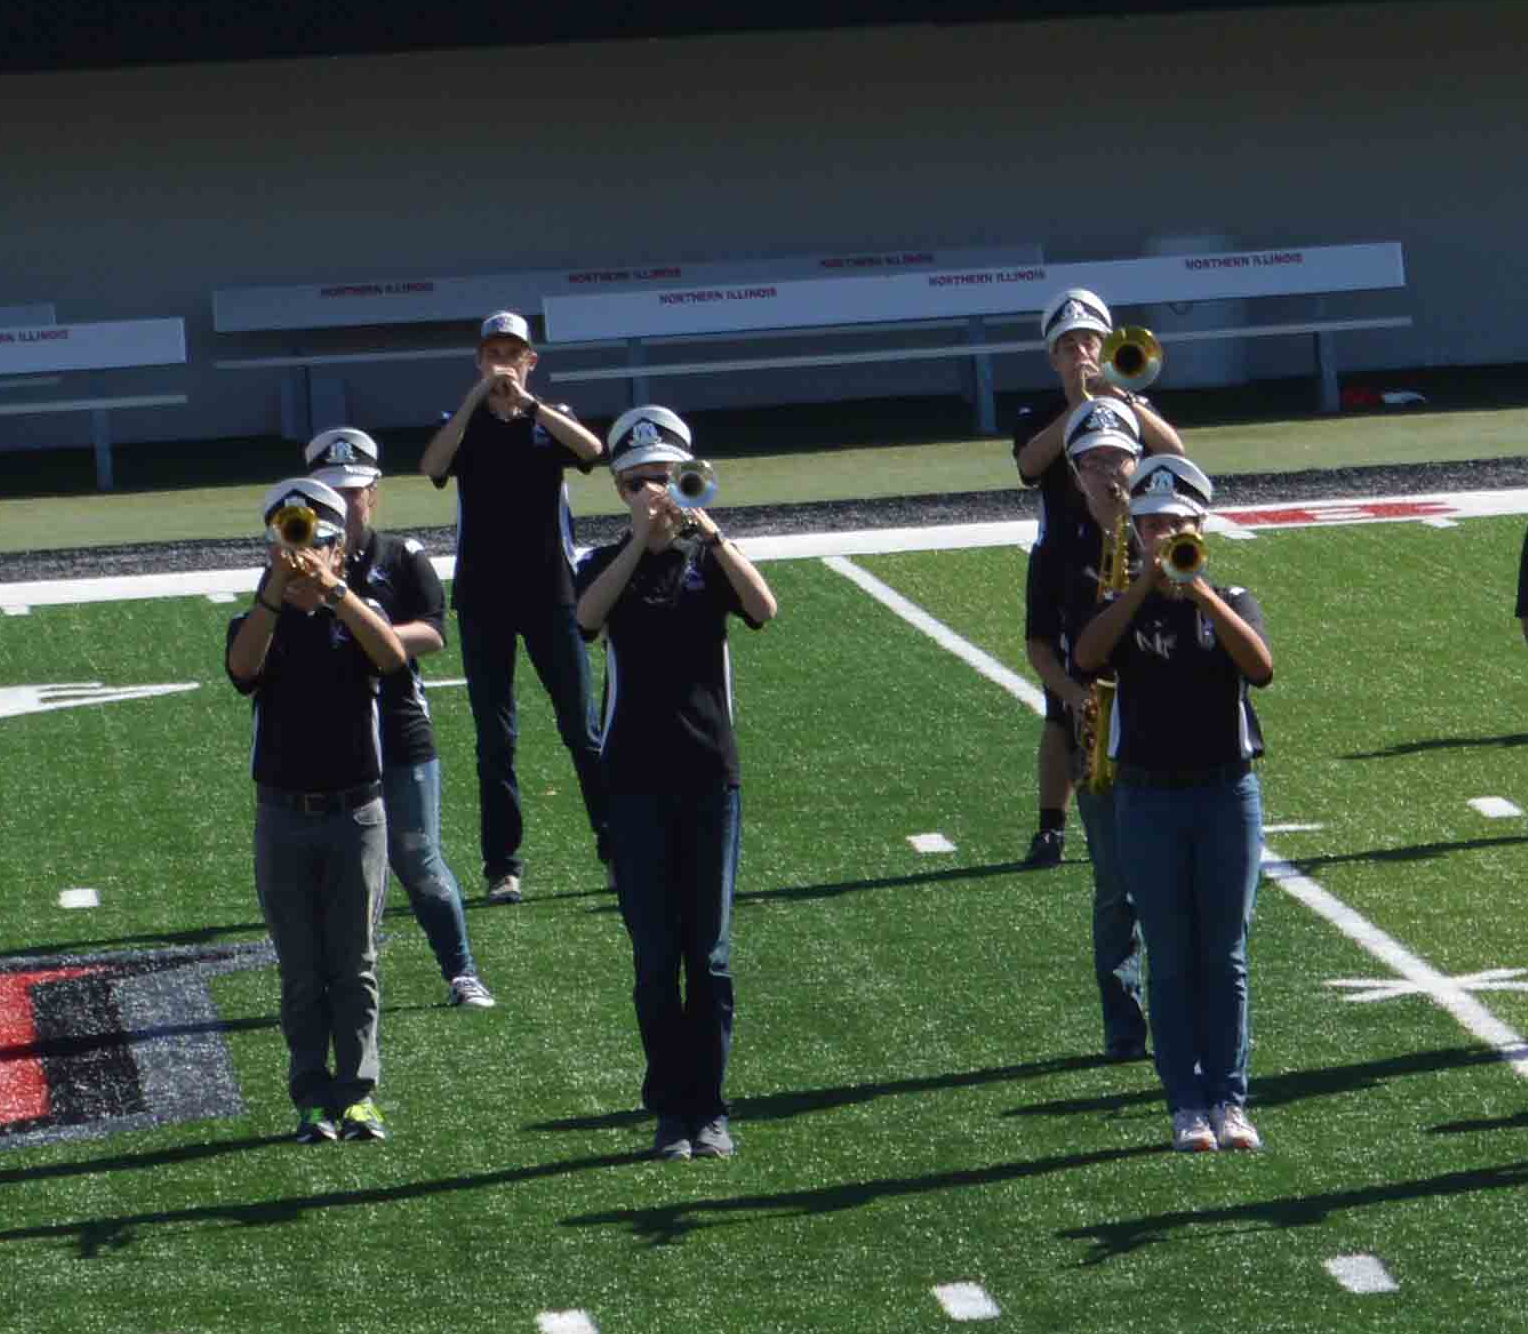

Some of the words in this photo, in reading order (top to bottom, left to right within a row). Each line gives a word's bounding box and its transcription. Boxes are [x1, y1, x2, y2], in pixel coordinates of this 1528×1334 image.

[1185, 255, 1250, 270] NORTHERN
[928, 272, 993, 287] NORTHERN
[658, 291, 723, 306] NORTHERN
